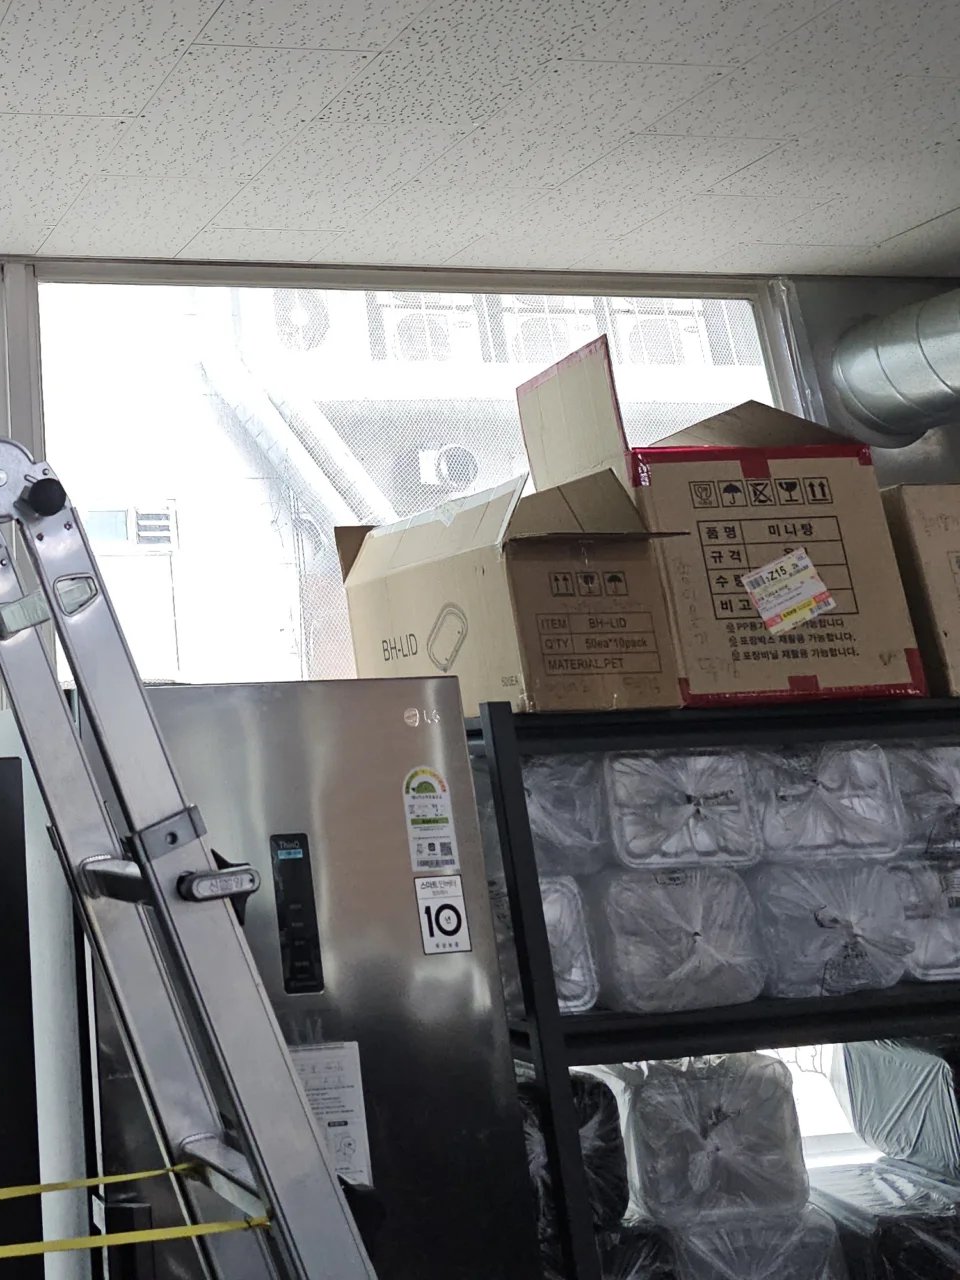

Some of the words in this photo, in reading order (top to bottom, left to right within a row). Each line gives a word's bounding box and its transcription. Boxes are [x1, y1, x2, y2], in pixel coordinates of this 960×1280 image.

[541, 618, 567, 629] ITEM
[588, 617, 627, 629] BH-LID
[382, 633, 418, 661] BH-LID
[425, 903, 462, 937] 10
